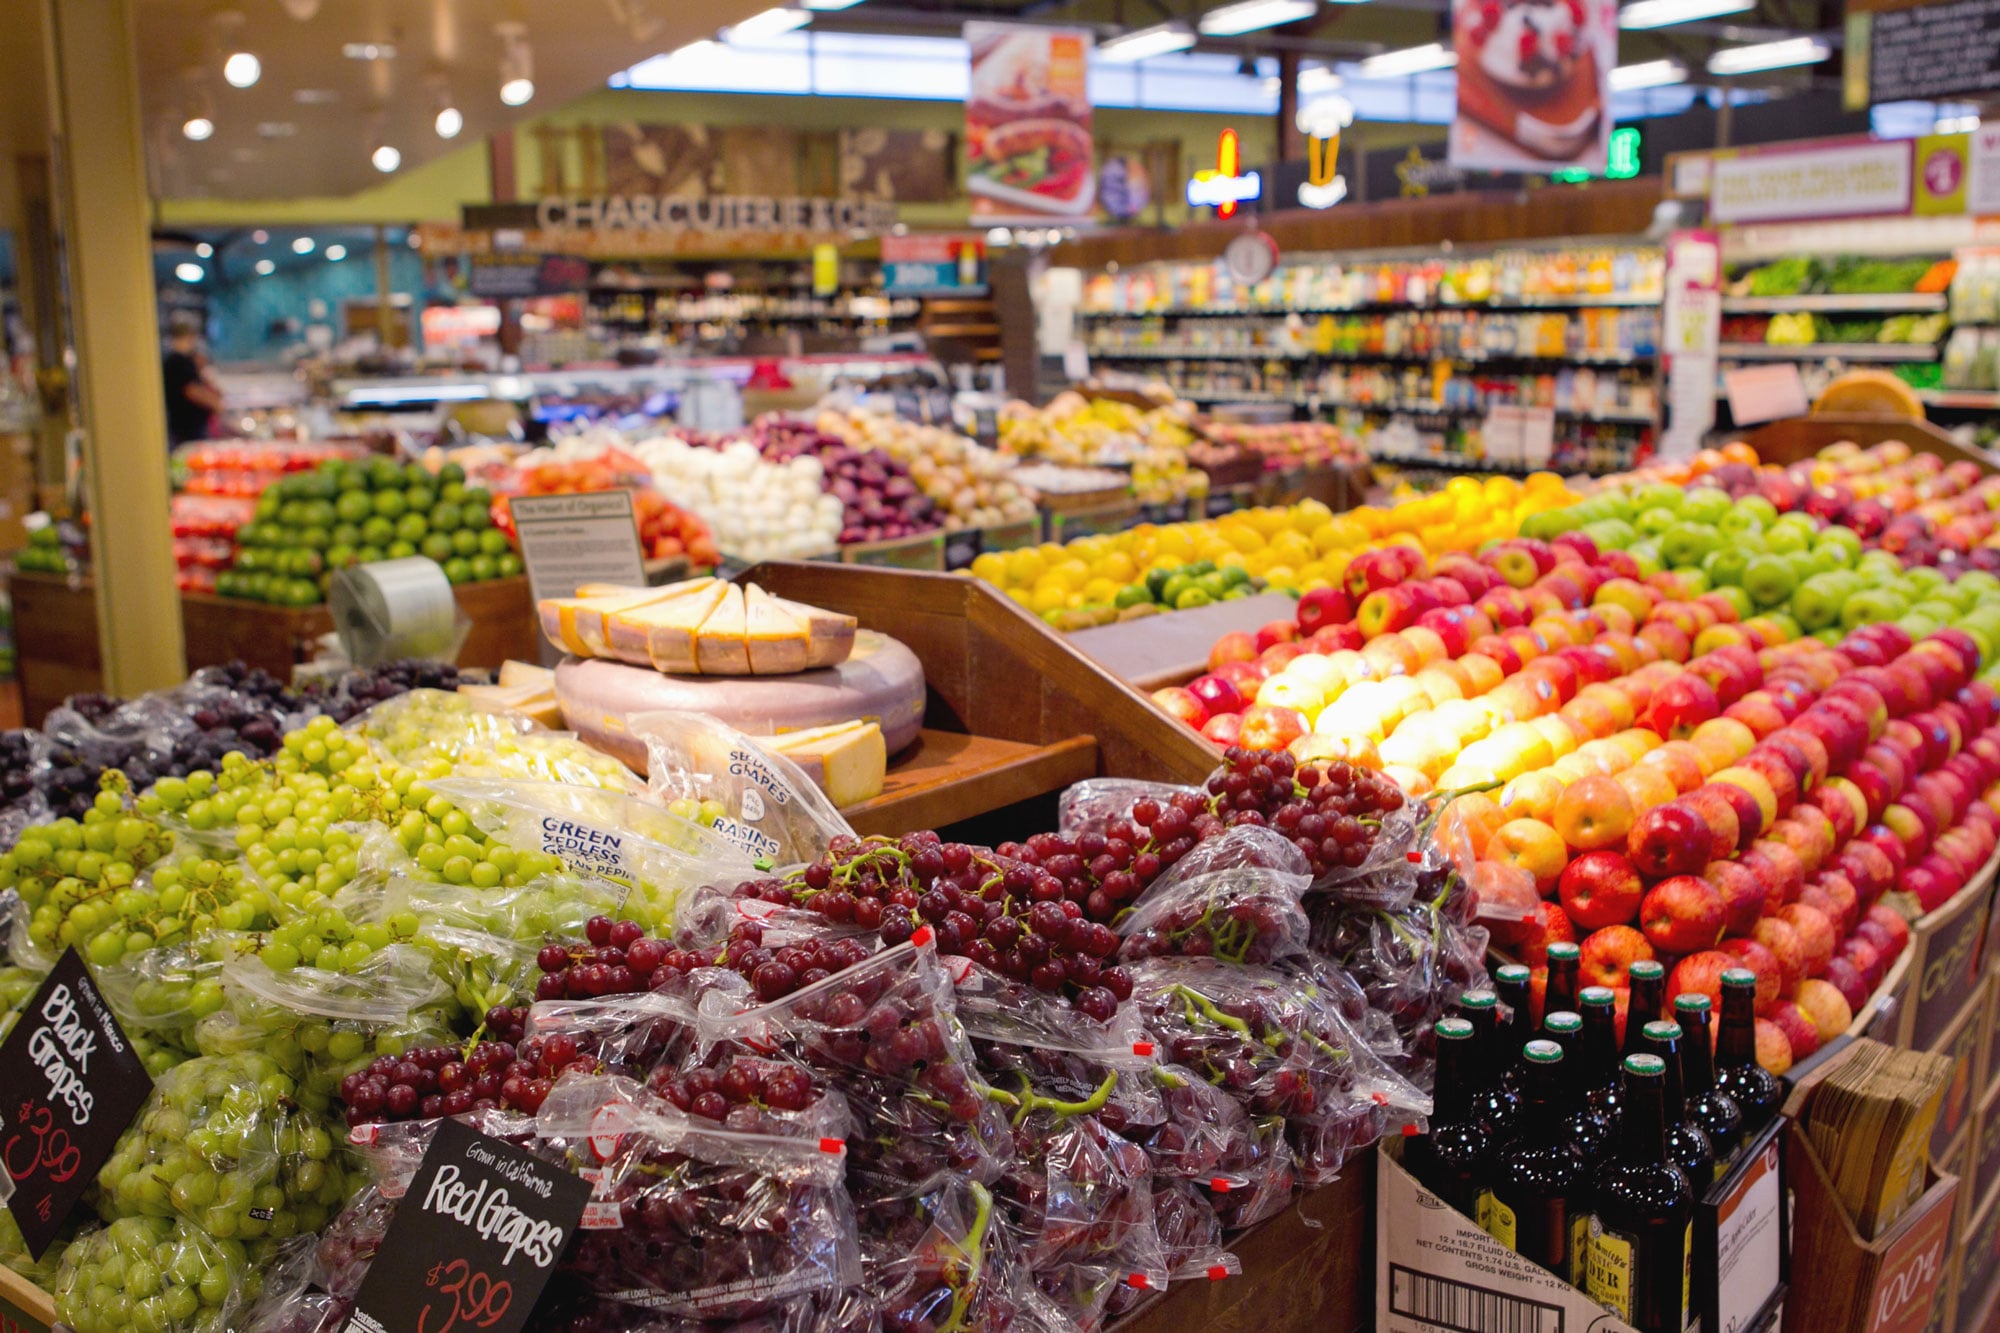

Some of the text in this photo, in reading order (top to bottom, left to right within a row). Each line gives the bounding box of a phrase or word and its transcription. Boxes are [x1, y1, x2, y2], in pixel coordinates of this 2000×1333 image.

[542, 817, 622, 849] GREEN
[41, 983, 97, 1075] Black
[28, 1026, 94, 1126] Grapes
[466, 1141, 496, 1166] Grown
[495, 1155, 508, 1174] in
[505, 1159, 554, 1198] California
[422, 1164, 564, 1268] Red Grapes
[1439, 1234, 1449, 1243] 12
[1477, 1243, 1504, 1257] FLUID
[1456, 1228, 1490, 1244] IMPORT
[1416, 1238, 1434, 1249] NET
[1435, 1244, 1483, 1262] CONTENTS
[1485, 1255, 1502, 1266] 1.74
[1504, 1260, 1522, 1272] U.S.
[1465, 1260, 1497, 1275] GROSS
[1498, 1268, 1534, 1285] WEIGHT
[1545, 1279, 1556, 1289] 12
[1557, 1281, 1571, 1293] KG
[1589, 1260, 1619, 1288] DER
[1873, 1239, 1940, 1333] 100%
